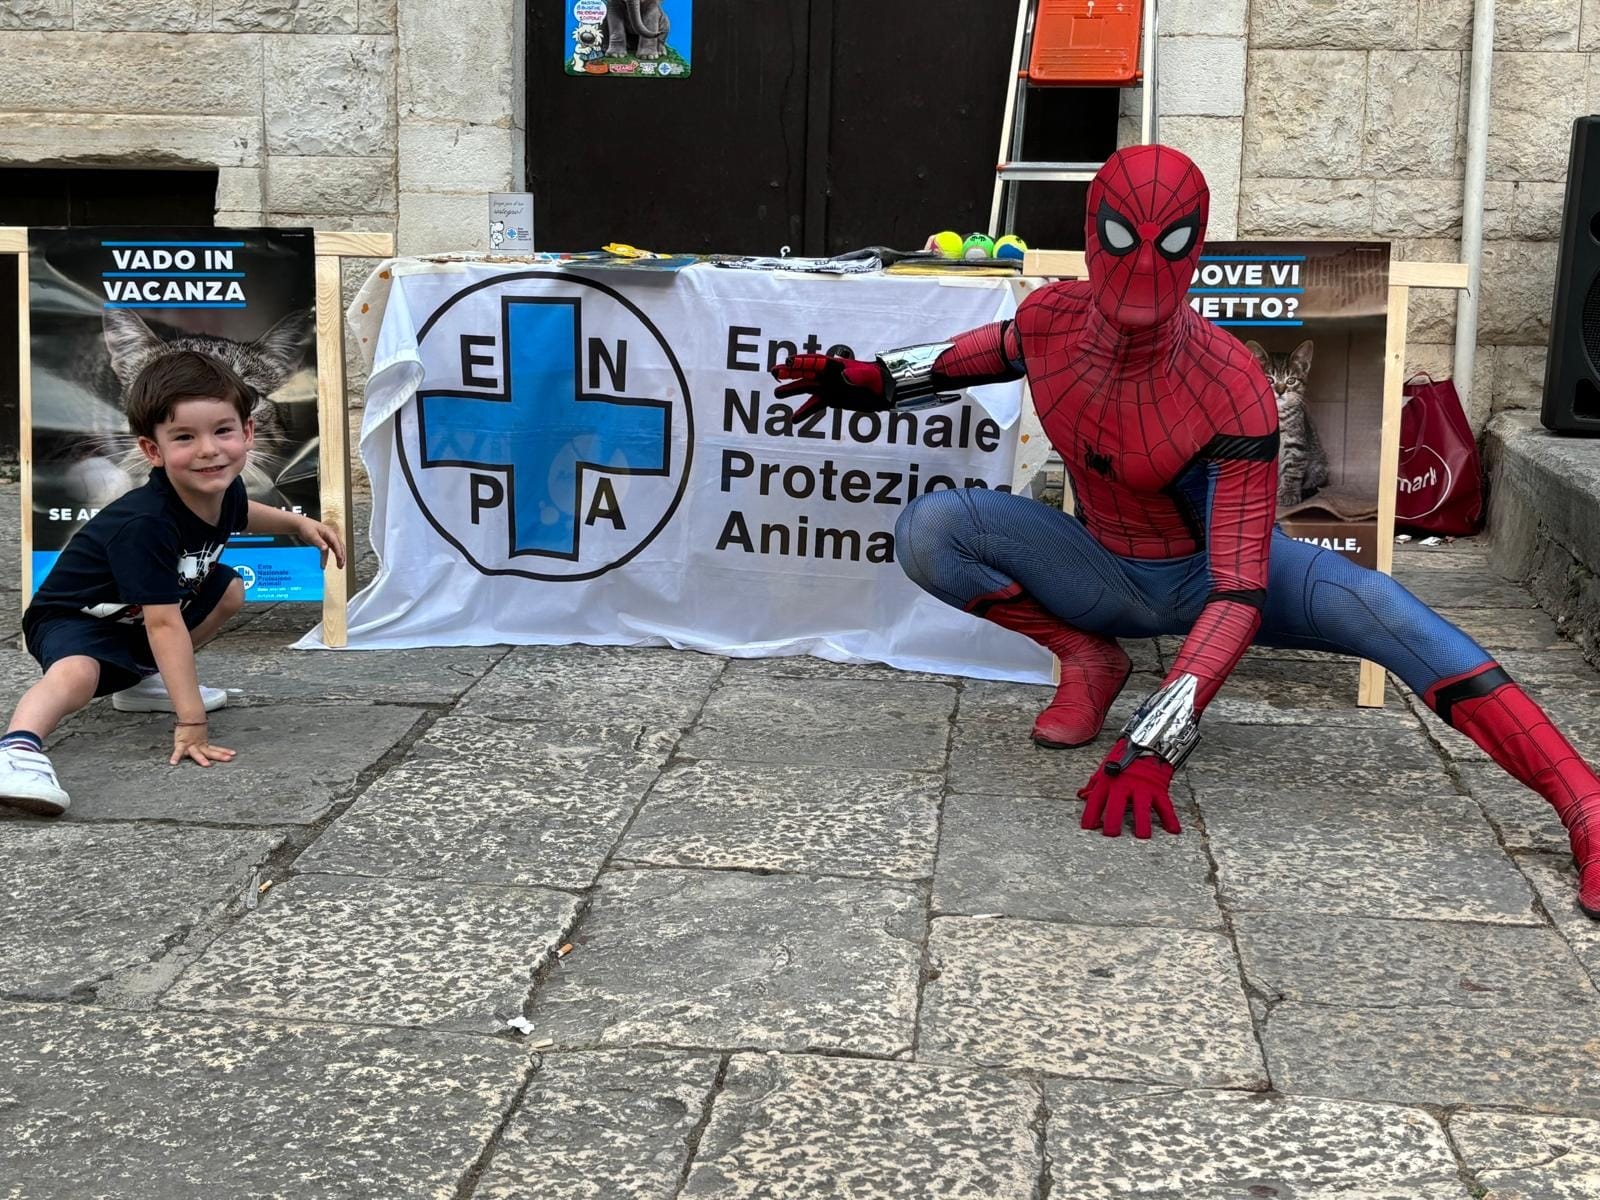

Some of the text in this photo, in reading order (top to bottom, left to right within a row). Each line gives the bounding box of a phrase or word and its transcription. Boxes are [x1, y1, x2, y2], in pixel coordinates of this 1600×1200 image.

[112, 249, 234, 270] VADO IN
[1270, 264, 1300, 285] VI
[102, 280, 246, 302] VACANZA
[460, 334, 627, 392] E N
[470, 473, 626, 530] P A
[48, 508, 73, 521] SE
[715, 510, 895, 564] Anima
